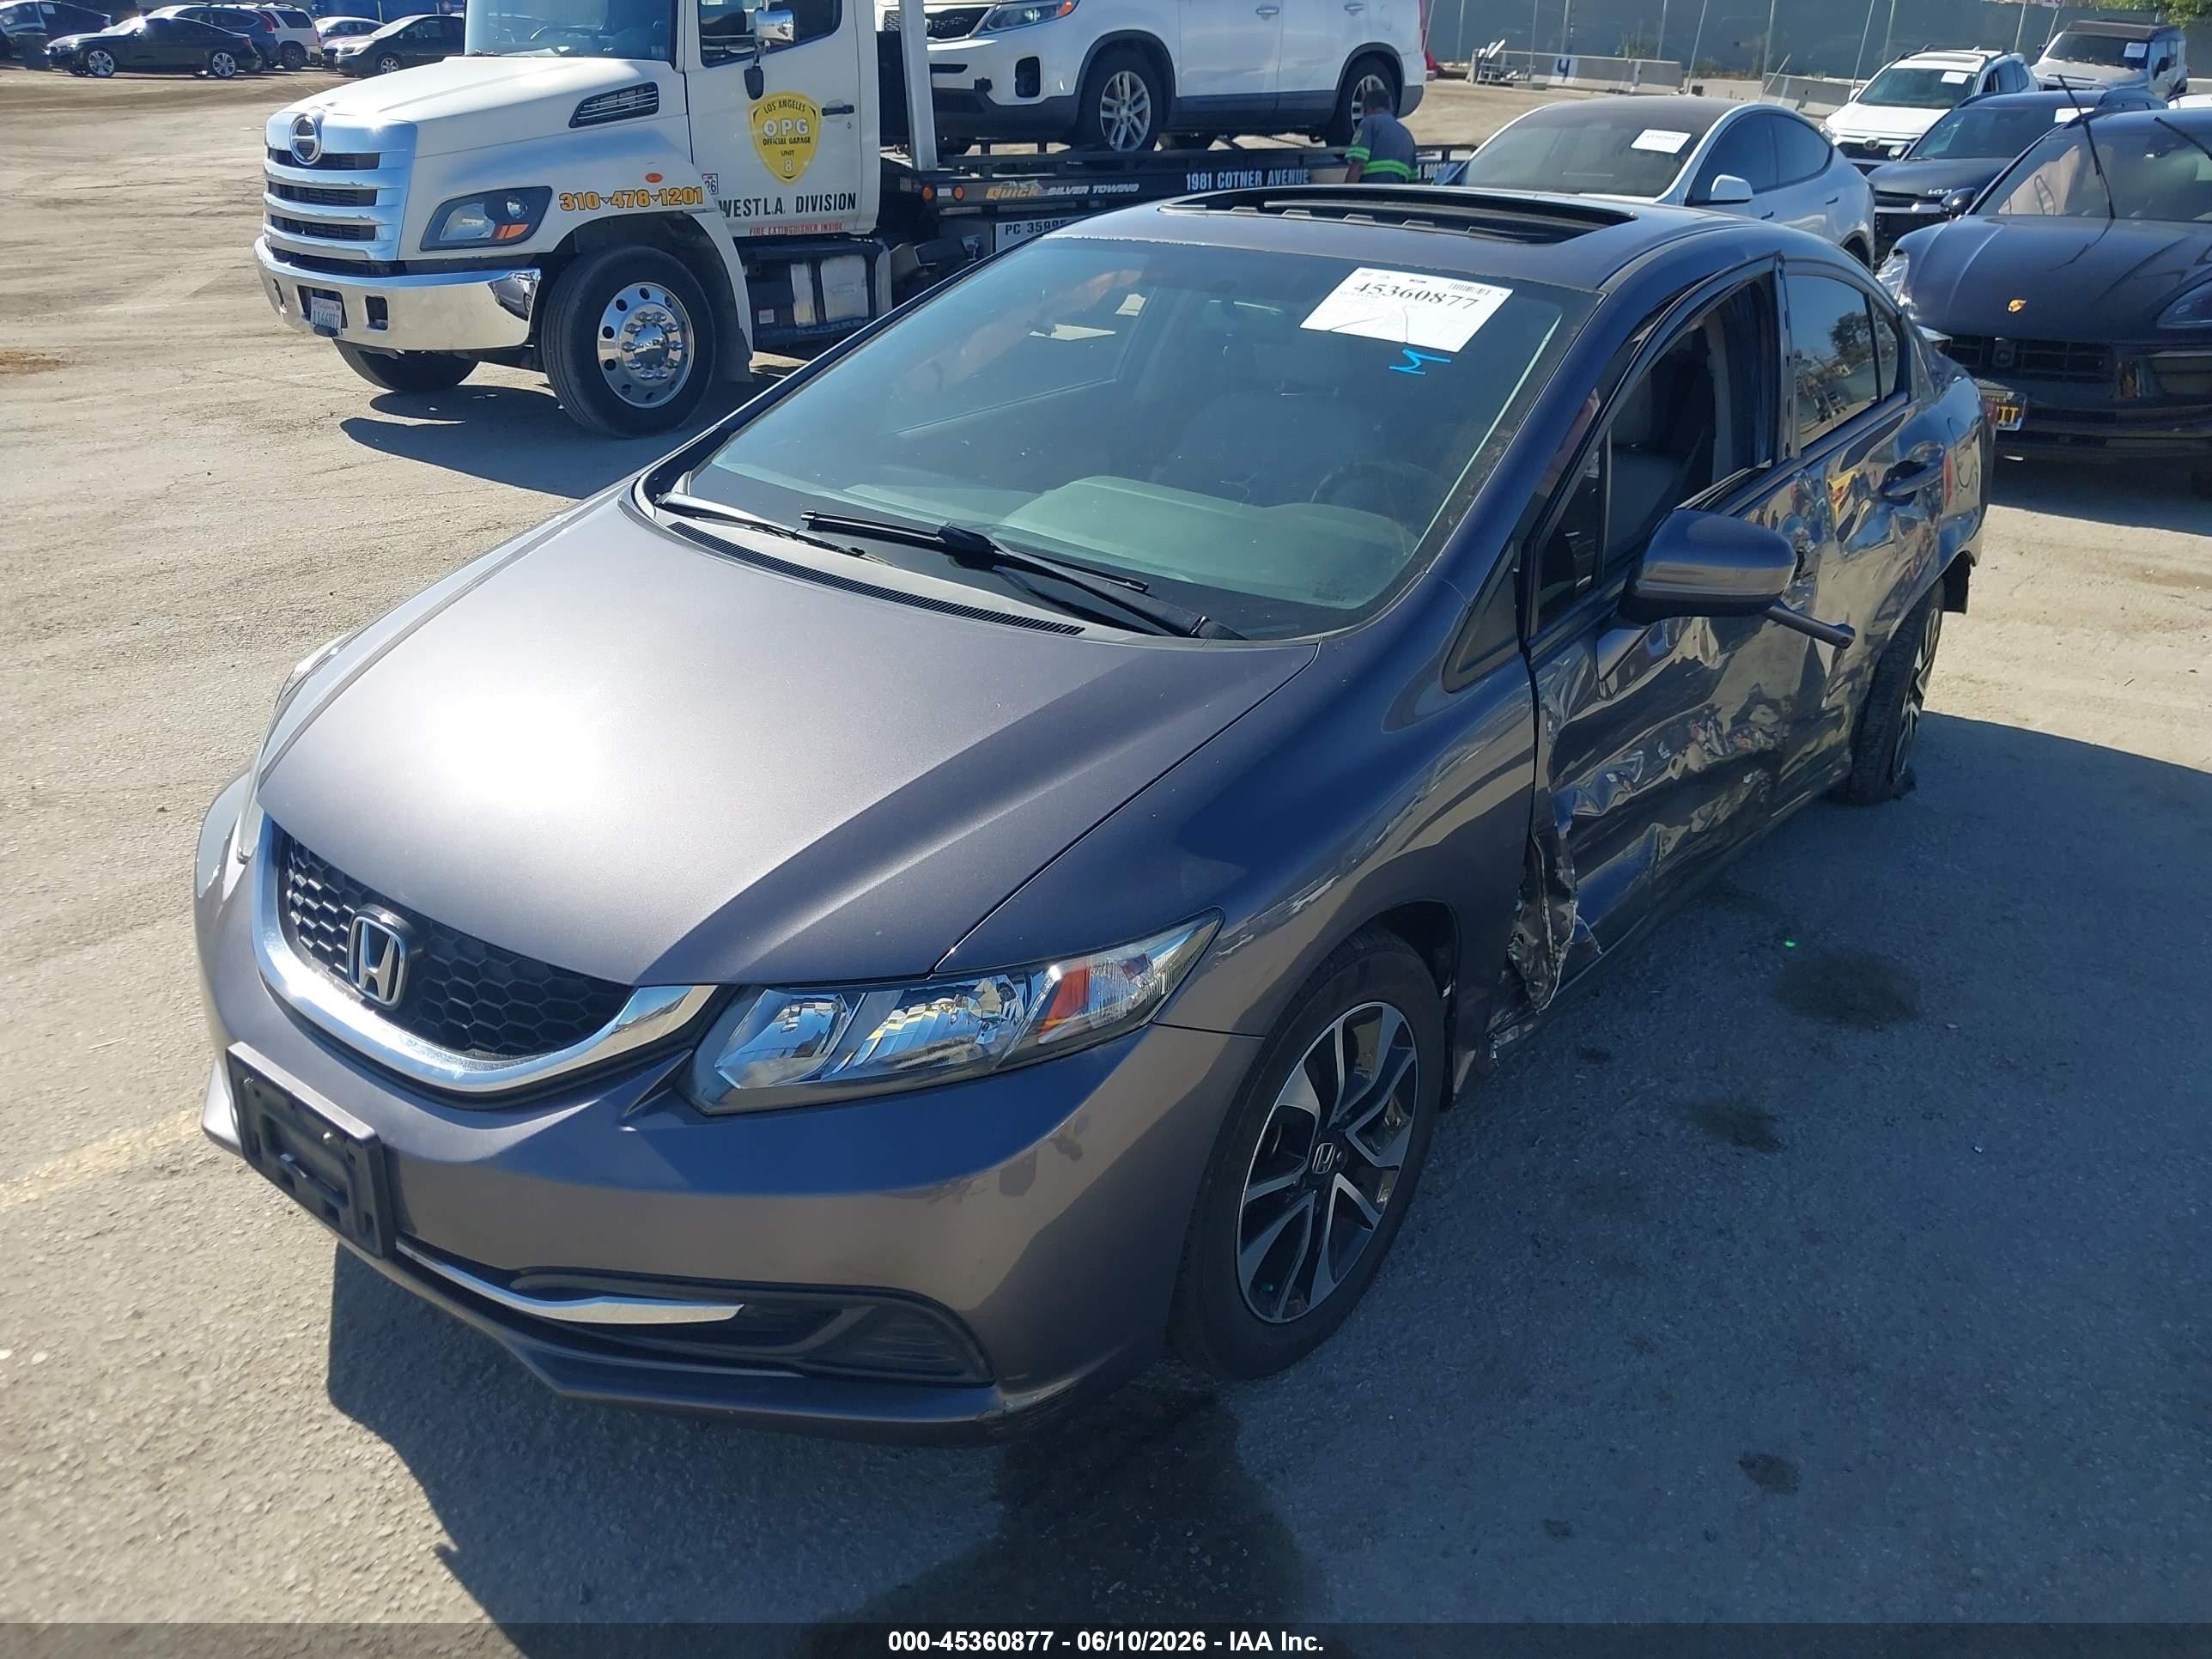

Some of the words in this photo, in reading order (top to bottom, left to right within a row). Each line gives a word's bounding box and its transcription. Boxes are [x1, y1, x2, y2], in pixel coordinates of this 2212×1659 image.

[763, 103, 776, 114] LOS
[778, 100, 806, 112] ANGELES
[763, 118, 810, 137] OPG
[763, 137, 787, 146] OFFICIAL
[784, 159, 793, 173] 8
[1186, 173, 1212, 191] 1981
[1217, 171, 1262, 190] COTNER
[1267, 169, 1310, 187] AVENUE
[1048, 185, 1089, 196] SILVER
[795, 192, 857, 214] DIVISION
[750, 227, 764, 236] FIRE
[820, 222, 843, 232] INSIDE
[1005, 223, 1021, 235] PC
[1354, 282, 1480, 309] 45360877
